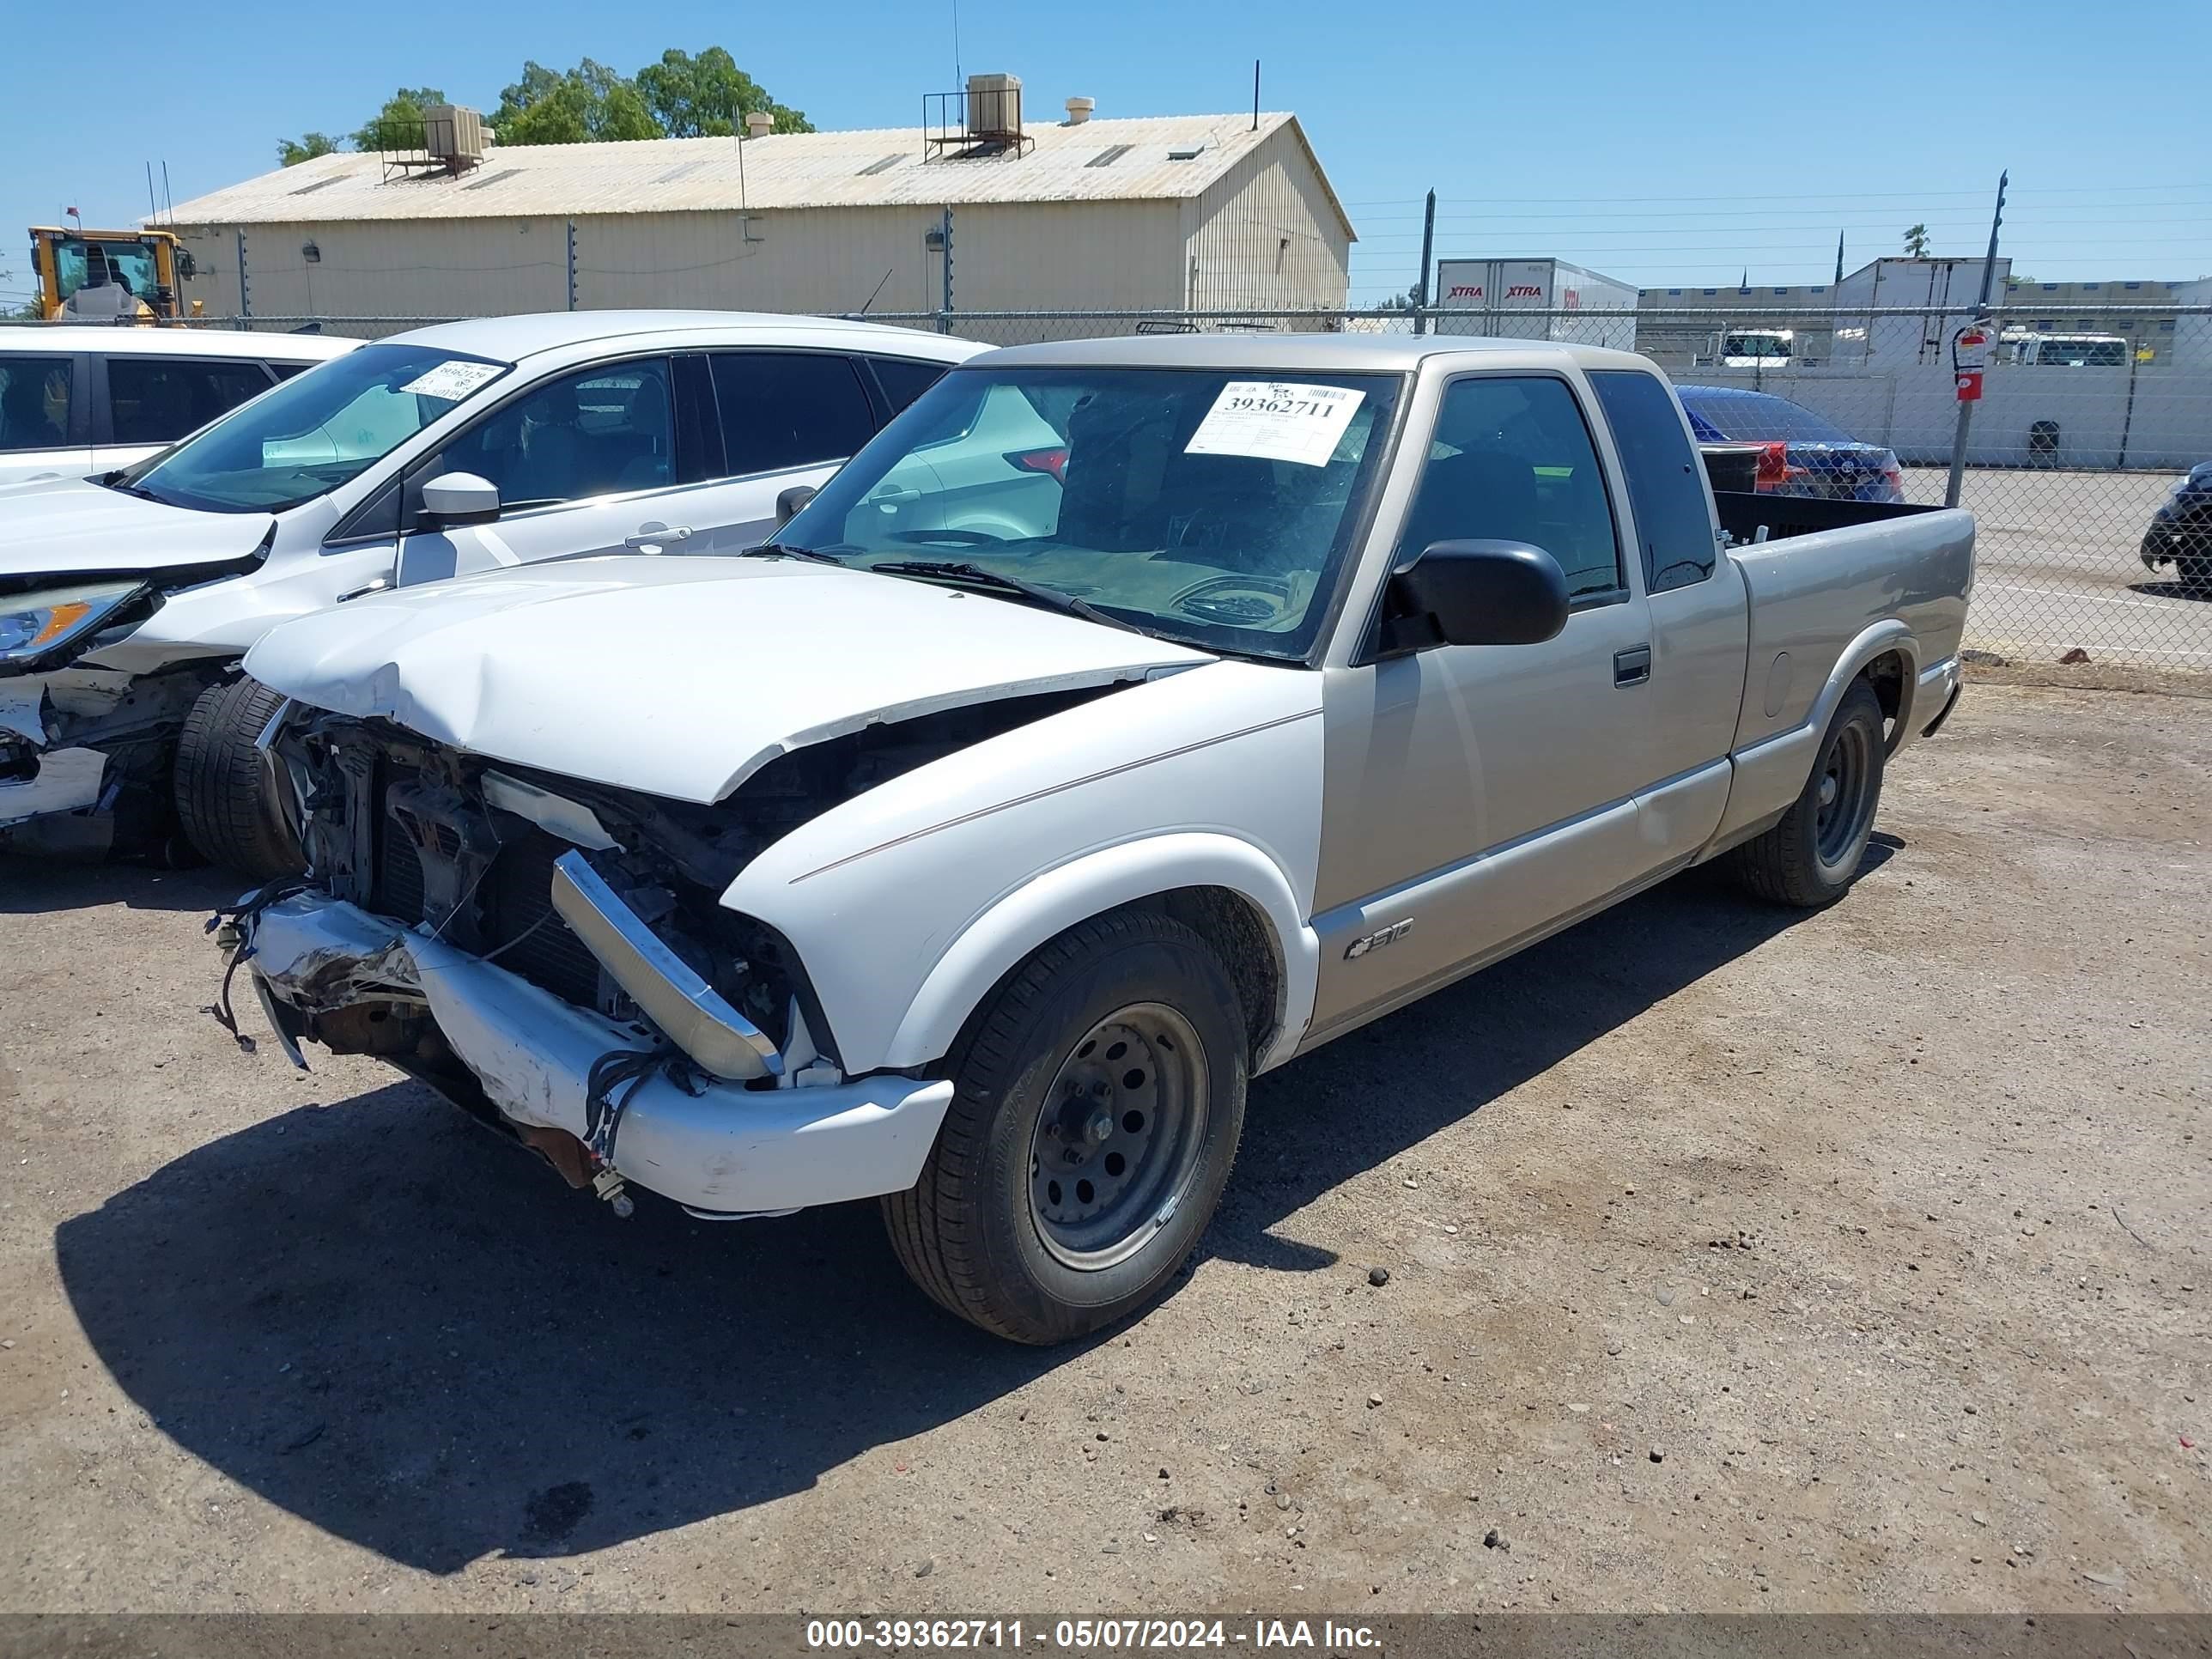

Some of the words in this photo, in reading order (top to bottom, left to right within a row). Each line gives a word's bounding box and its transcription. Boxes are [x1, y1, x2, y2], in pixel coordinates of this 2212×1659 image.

[1447, 286, 1483, 299] XTRA
[1504, 285, 1541, 299] XTRA
[1224, 397, 1334, 418] 39362711
